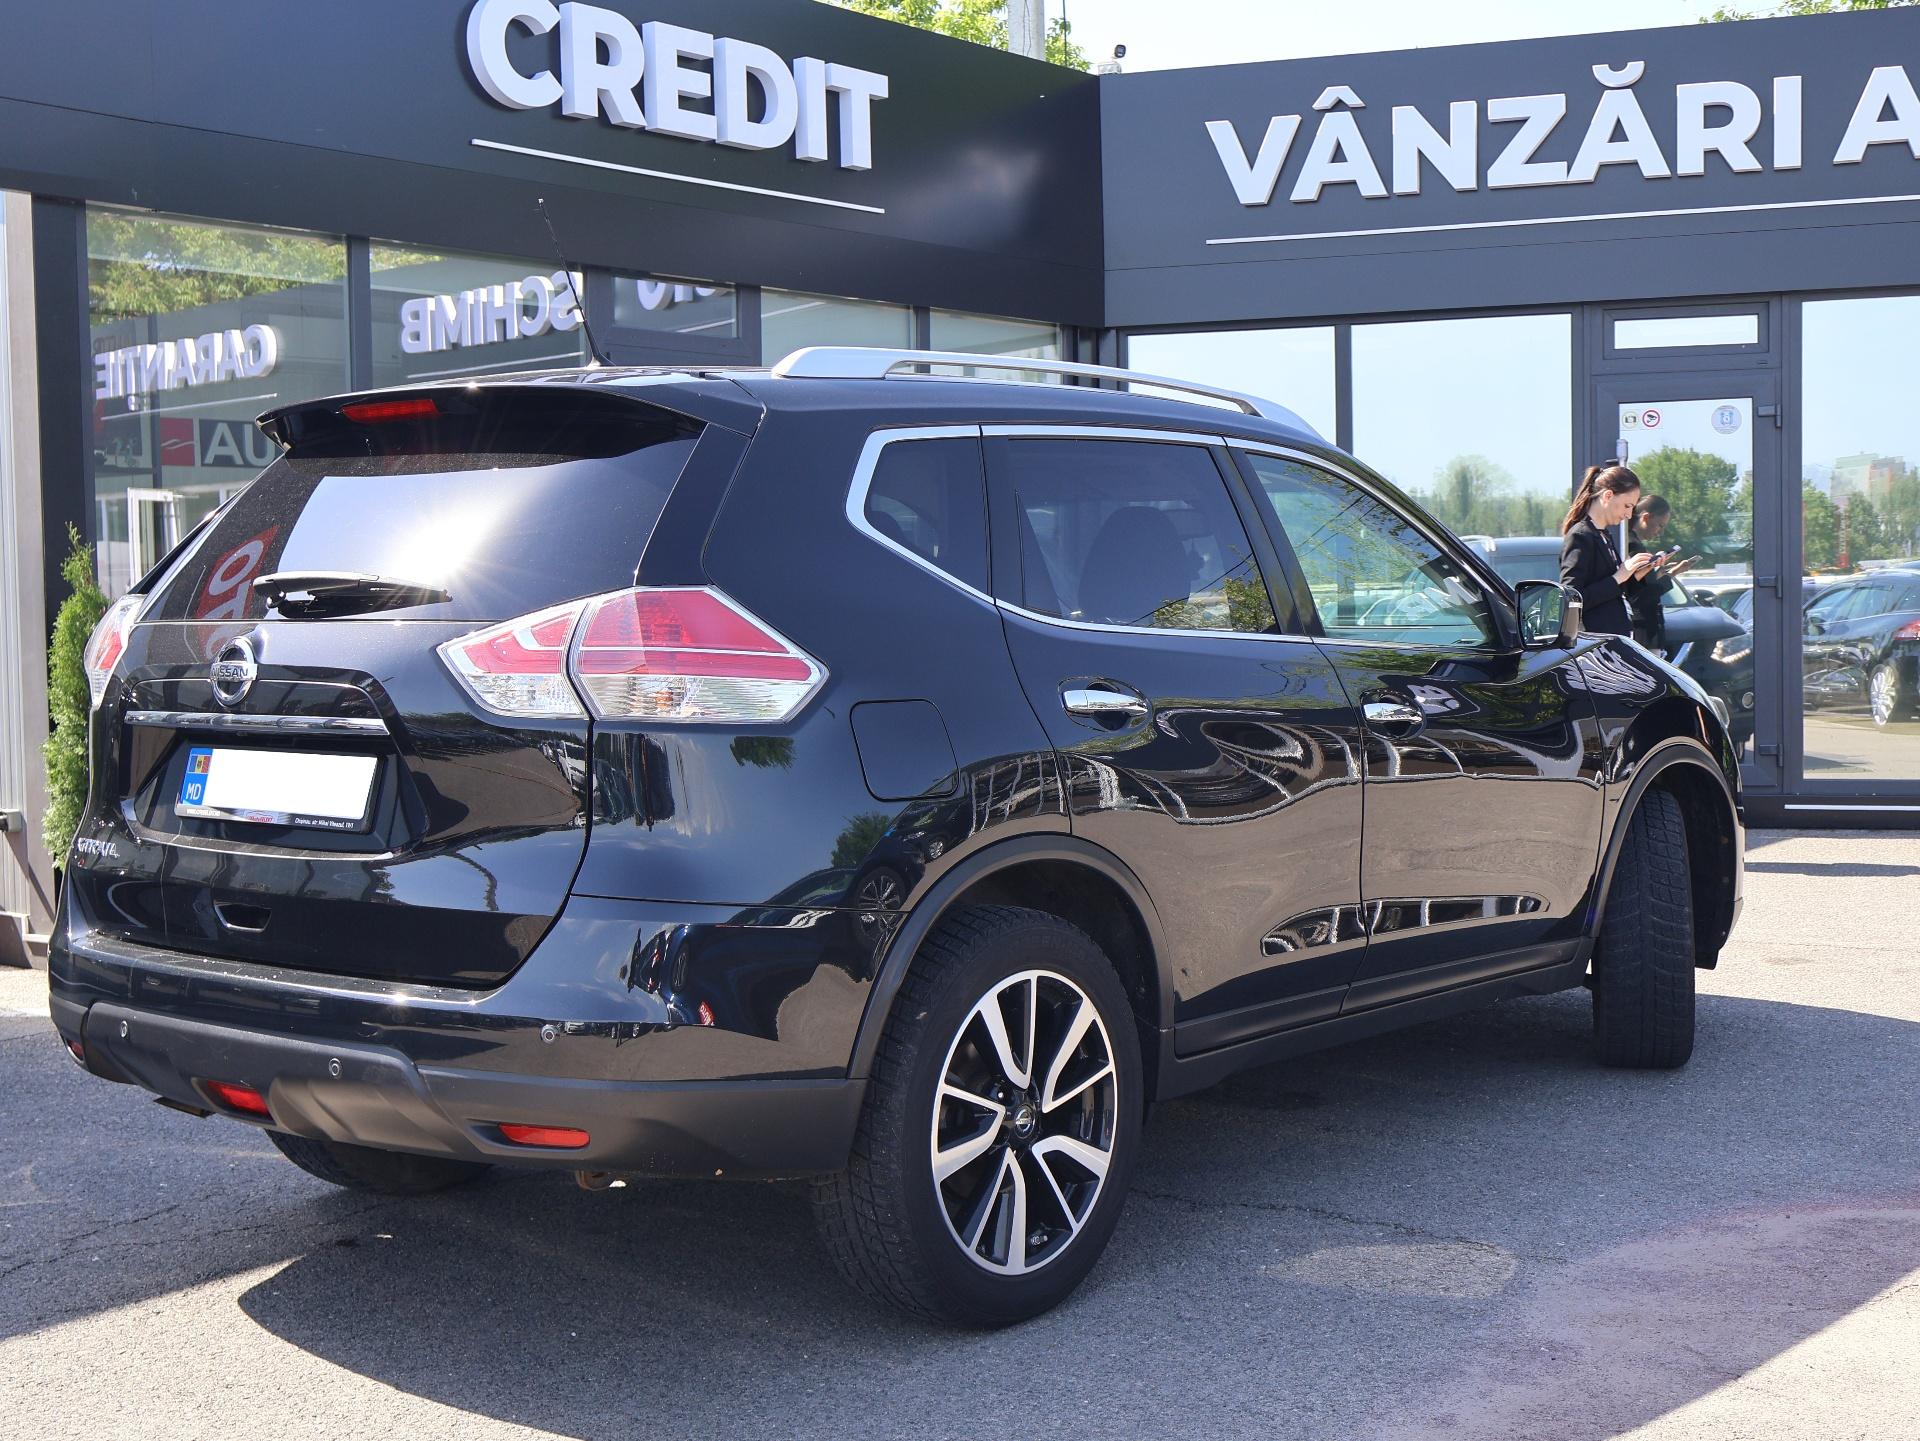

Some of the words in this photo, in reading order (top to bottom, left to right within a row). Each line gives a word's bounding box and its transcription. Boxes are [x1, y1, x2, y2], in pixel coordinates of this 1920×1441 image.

[466, 0, 889, 171] CREDIT
[1205, 60, 1802, 206] VÂNZĂRI
[211, 665, 250, 678] NISSAN
[186, 783, 202, 800] MD
